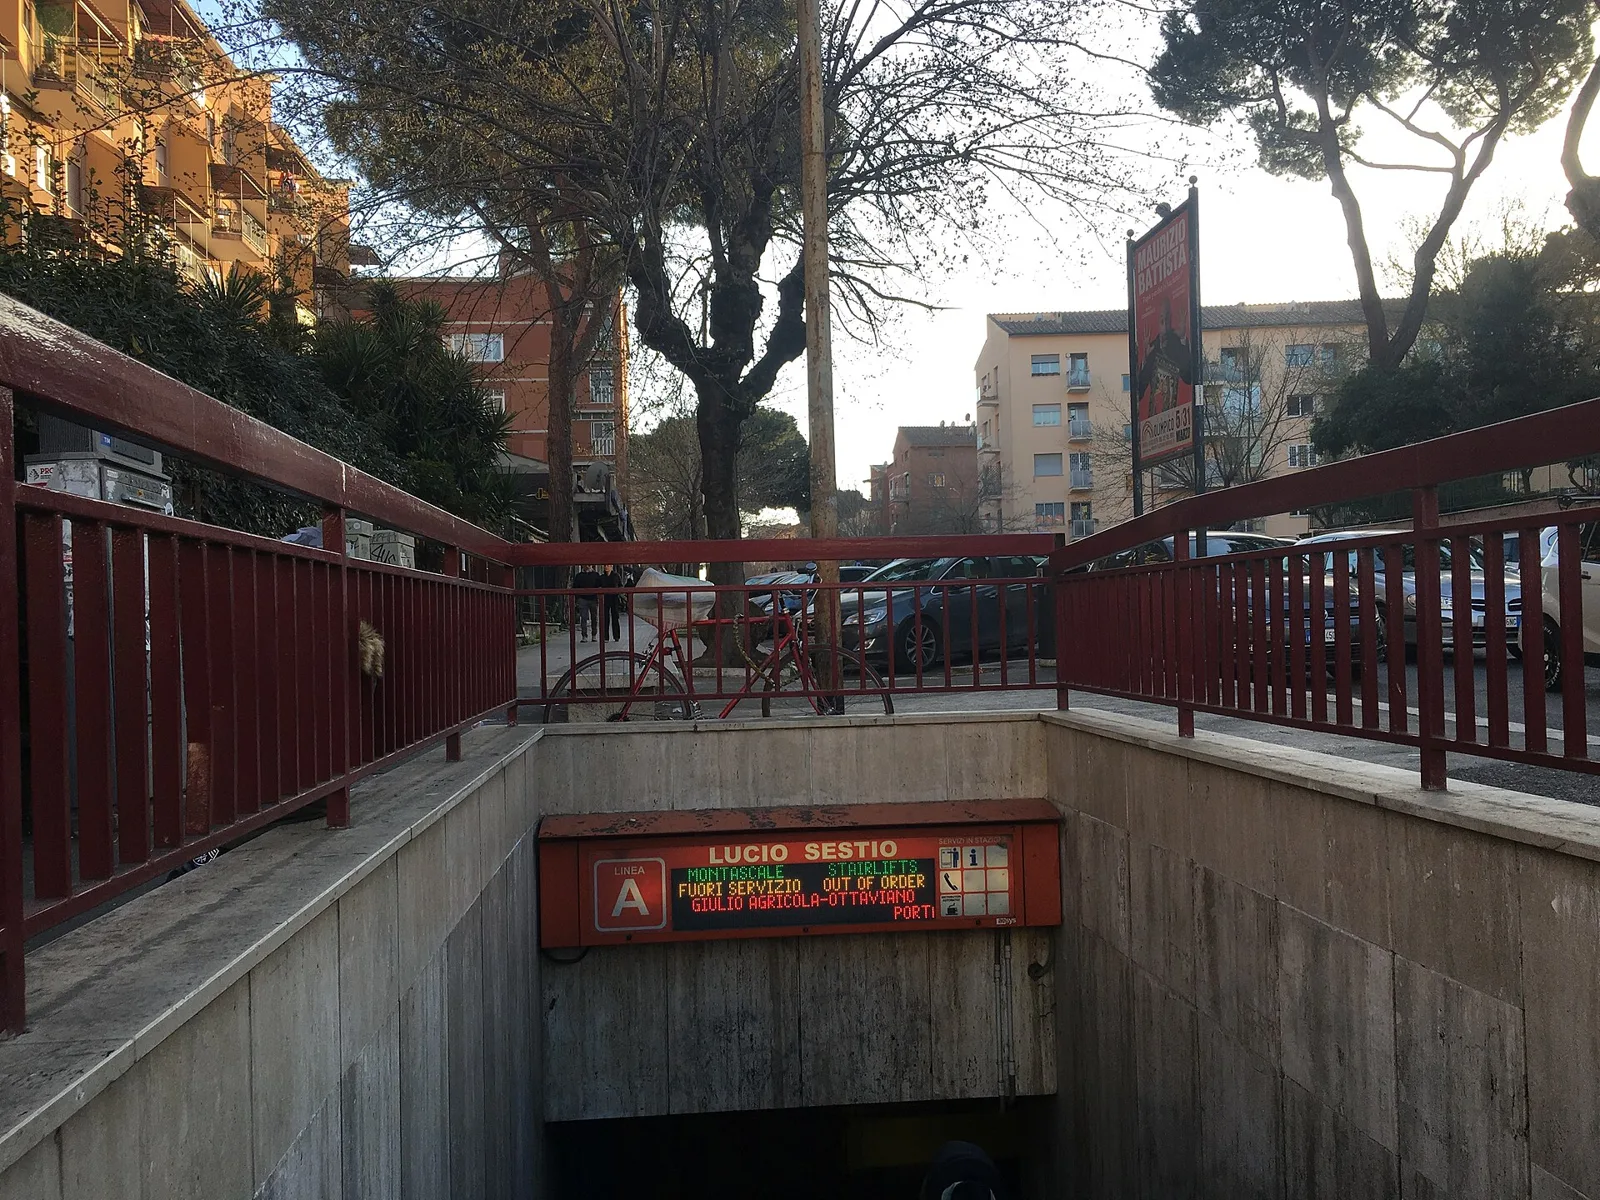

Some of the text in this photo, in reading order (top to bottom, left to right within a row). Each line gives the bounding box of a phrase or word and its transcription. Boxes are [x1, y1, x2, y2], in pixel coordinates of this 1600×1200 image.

[1137, 218, 1186, 275] MAURIZIO
[1137, 243, 1188, 297] BATTISTA
[709, 840, 898, 864] LUCIO SESTIO
[939, 837, 965, 845] SERVIZI
[966, 836, 974, 844] IN
[614, 866, 646, 876] LINEA
[687, 859, 919, 882] MONTASCALE STAIRLIFTS
[611, 878, 650, 917] A
[678, 873, 926, 898] FUORI SERVIZIO OUT OF ORDER
[691, 888, 916, 912] GIULIO AGRICOLA-OTTAVIANO
